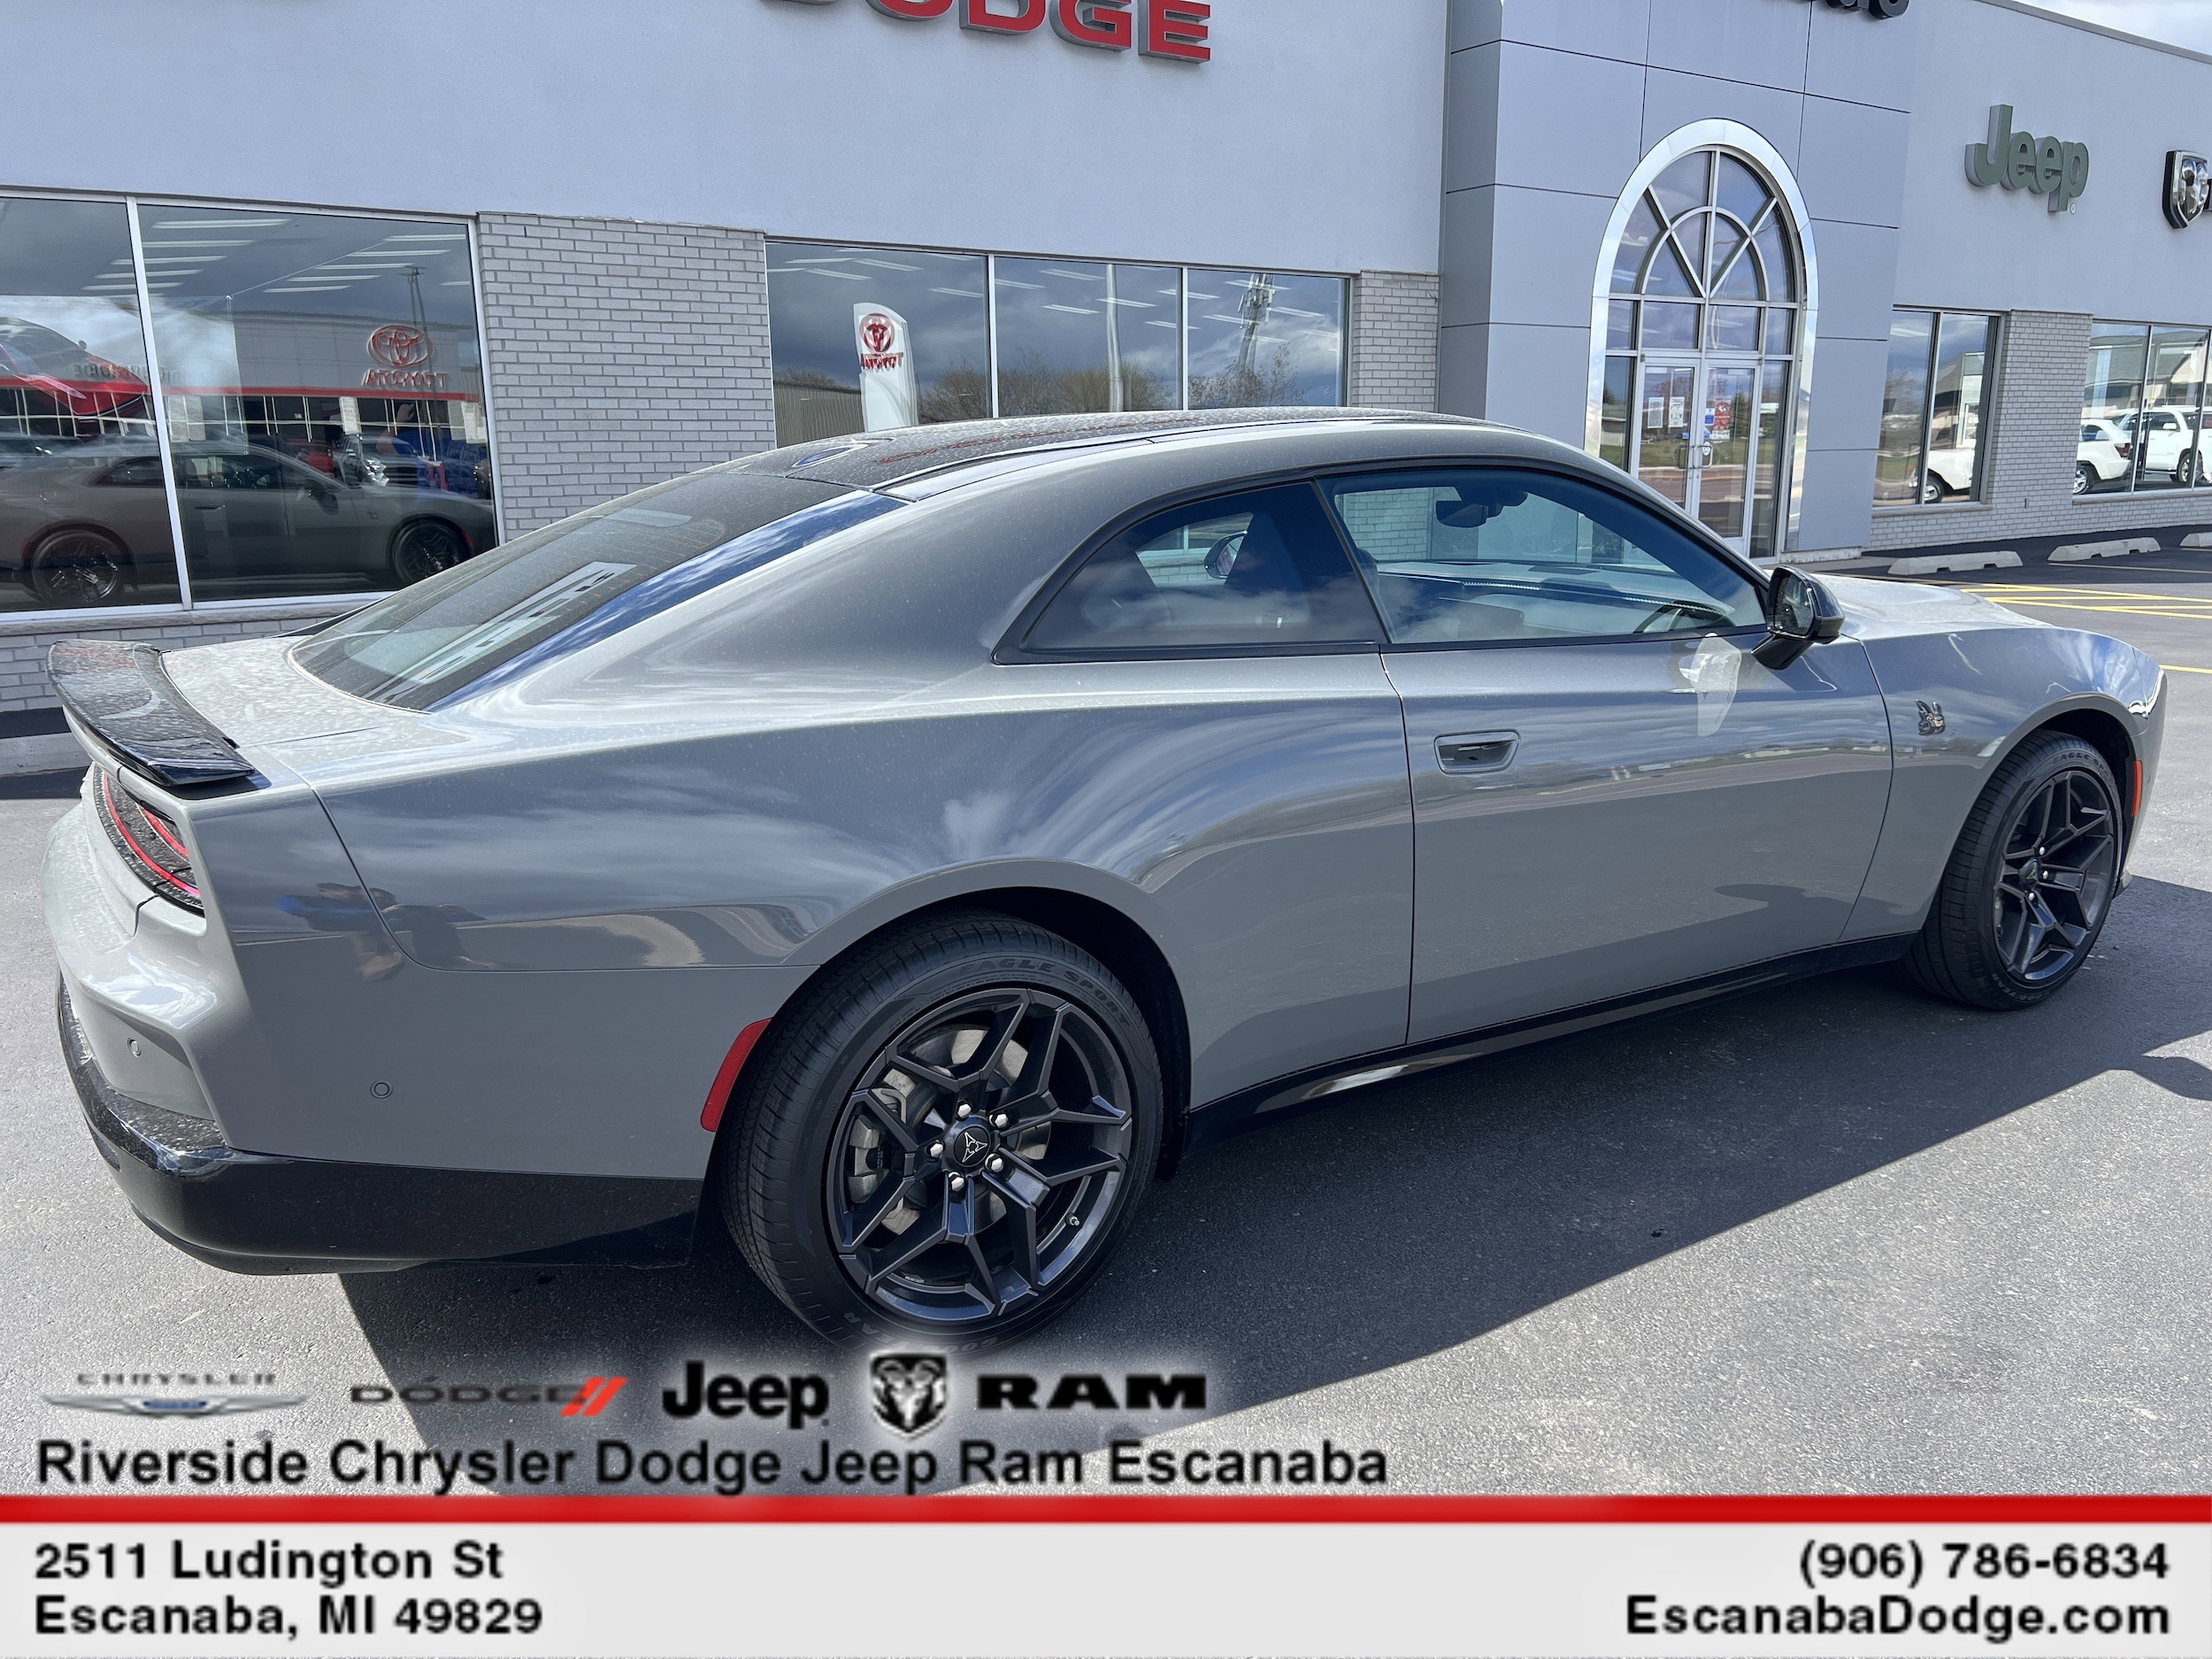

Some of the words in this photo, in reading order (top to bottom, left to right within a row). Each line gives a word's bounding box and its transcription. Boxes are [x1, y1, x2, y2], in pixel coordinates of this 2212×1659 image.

[759, 0, 1211, 64] DGE
[1964, 104, 2089, 212] Jeep
[958, 958, 1056, 978] EAGLE
[1064, 970, 1132, 1027] SPORT
